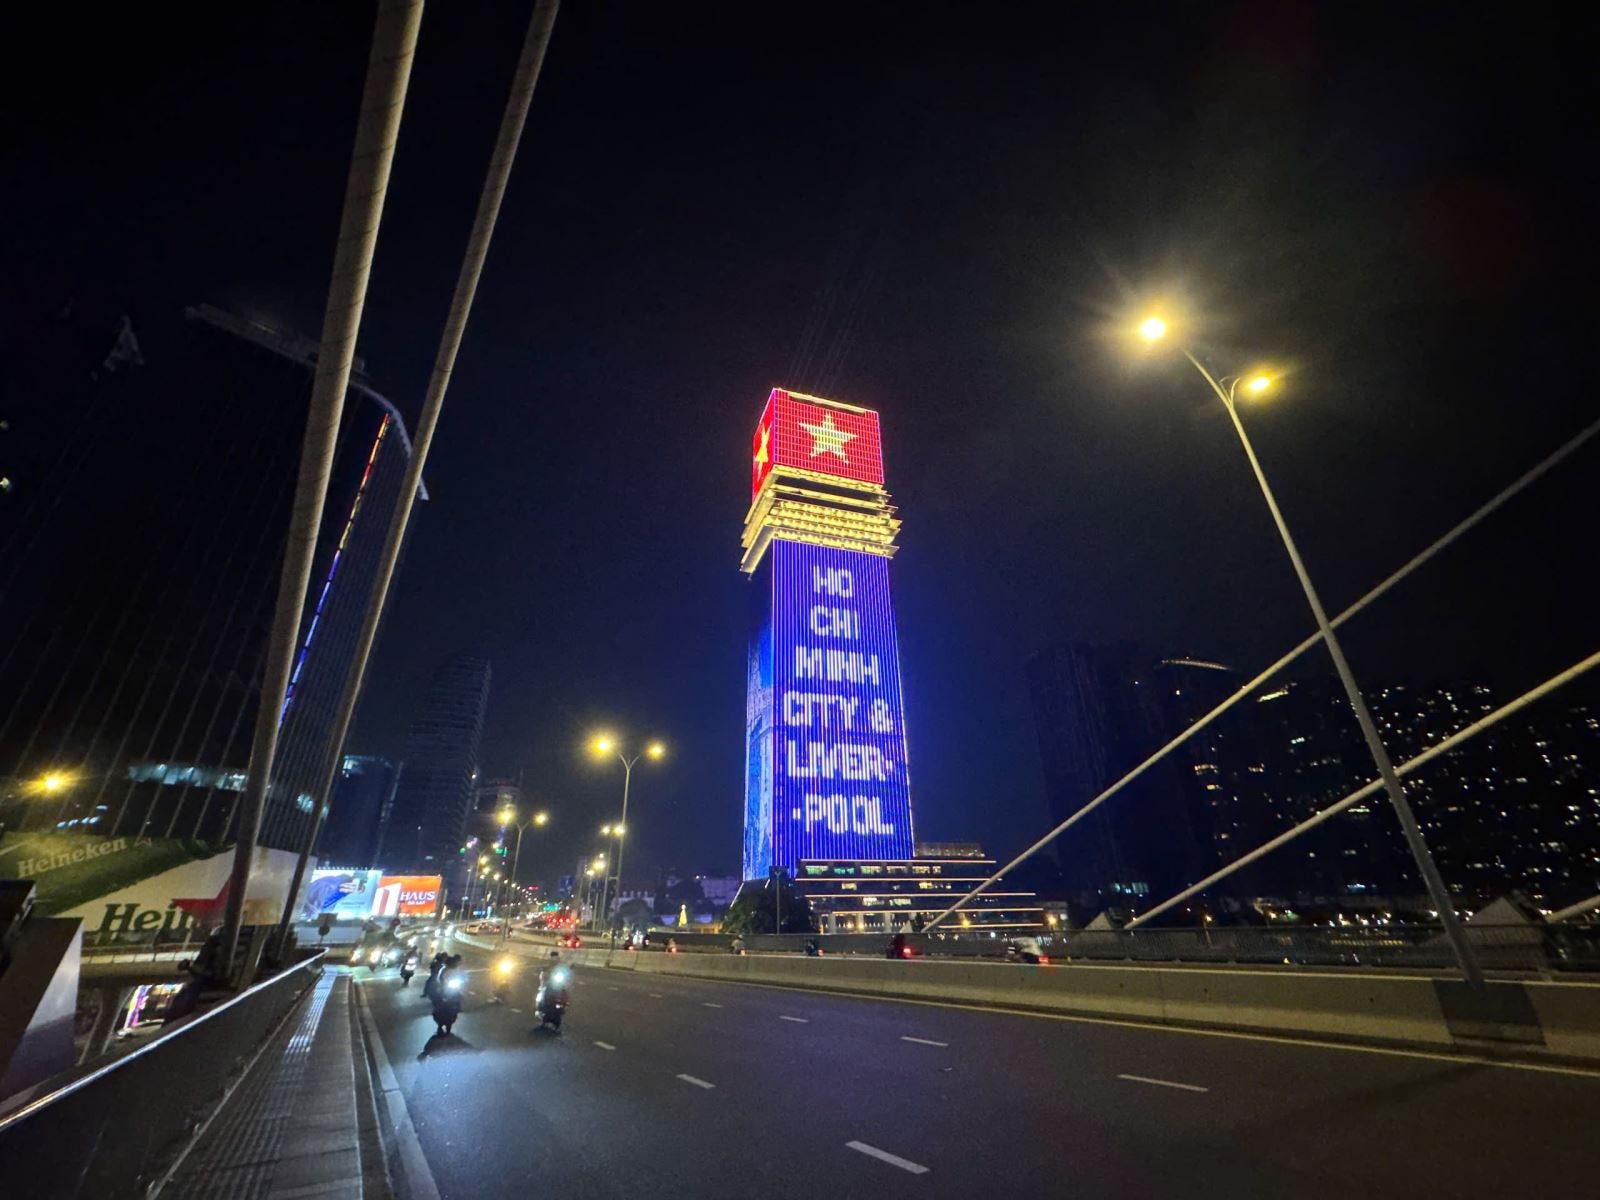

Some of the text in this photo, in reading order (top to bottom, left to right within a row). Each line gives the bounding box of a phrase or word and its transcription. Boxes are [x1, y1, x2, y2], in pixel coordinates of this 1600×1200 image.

[813, 565, 853, 598] HO
[810, 604, 859, 640] CHI
[795, 645, 879, 686] MINH
[783, 690, 858, 730] CITY
[17, 837, 128, 878] Heineken
[400, 890, 436, 902] HAUS
